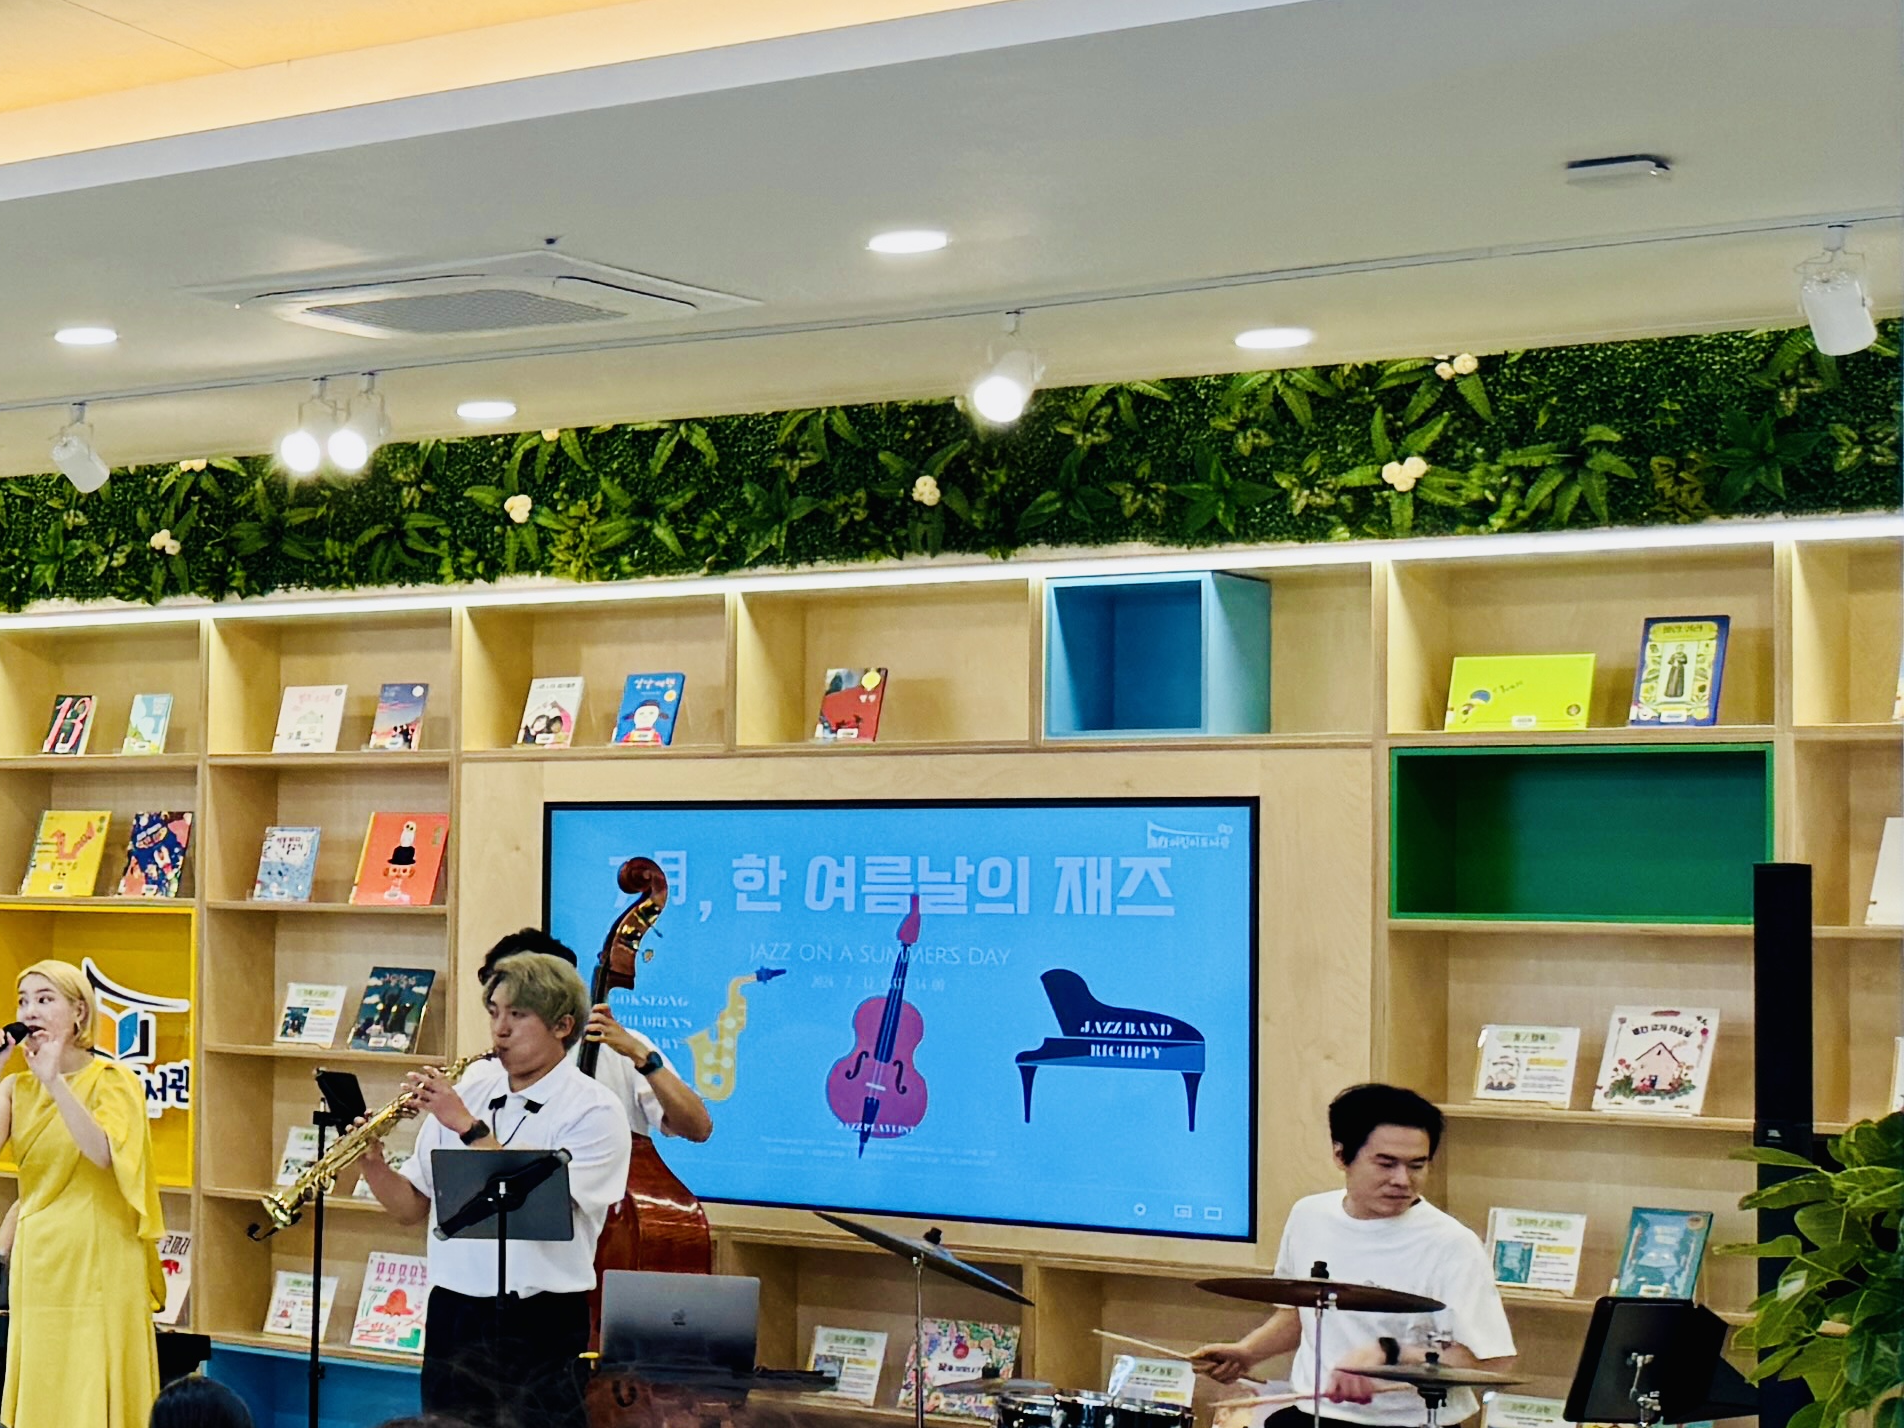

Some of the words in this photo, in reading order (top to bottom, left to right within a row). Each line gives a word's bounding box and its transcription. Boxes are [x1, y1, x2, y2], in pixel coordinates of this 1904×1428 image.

[732, 853, 787, 912] 한
[804, 854, 1030, 915] 여름날의
[1054, 856, 1176, 917] 재즈
[749, 943, 792, 963] JAZZ
[799, 943, 833, 962] ON
[839, 945, 853, 963] A
[969, 947, 1011, 965] DAY
[616, 1013, 692, 1029] HILDREN'S
[133, 1065, 190, 1103] 서관
